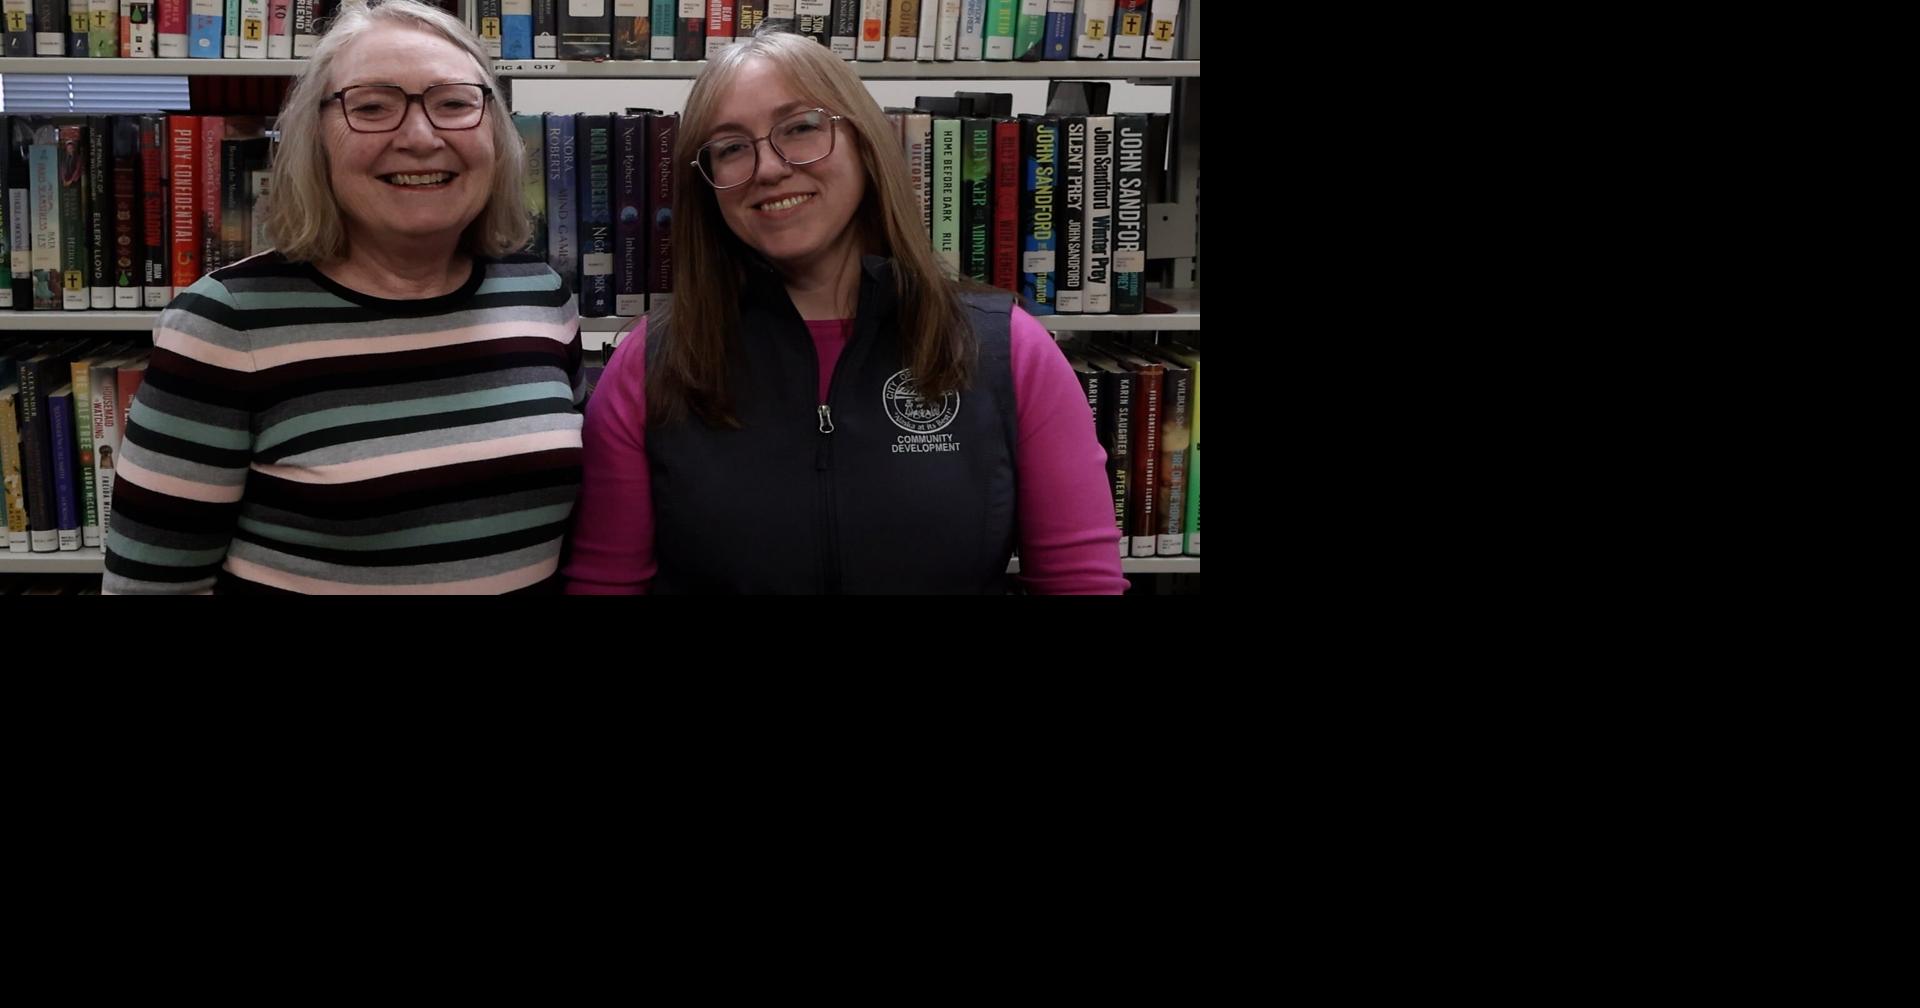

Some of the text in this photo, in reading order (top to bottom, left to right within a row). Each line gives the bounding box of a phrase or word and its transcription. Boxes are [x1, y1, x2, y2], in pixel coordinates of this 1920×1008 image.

[740, 5, 753, 30] LANDS
[174, 129, 193, 161] PONY
[548, 127, 563, 181] ROBERTS
[562, 135, 576, 173] NORA
[622, 127, 636, 195] Nora Roberts
[972, 129, 989, 162] RILEY
[1034, 124, 1055, 163] JOHN
[1119, 127, 1143, 172] JOHN
[206, 129, 215, 229] CHAMPAGNE LETTERS
[590, 128, 608, 218] NORA ROBERTS
[657, 128, 672, 199] Nora Roberts
[942, 130, 953, 223] HOME BEFORE DARK
[1066, 123, 1085, 211] SILENT PREY
[1093, 127, 1112, 210] John Sandford
[173, 164, 193, 244] CONFIDENTIAL
[1033, 166, 1054, 241] SANDFORD
[1116, 177, 1142, 251] SANDFOR
[92, 212, 103, 279] ELLERY LLOYD
[557, 188, 570, 267] MIND GAMES
[942, 232, 952, 252] RILE
[971, 223, 987, 266] MIDDLE
[1067, 219, 1081, 242] JOHN
[1091, 215, 1111, 255] Winter
[624, 236, 637, 293] Inheritance
[1066, 242, 1081, 288] SANDFORD
[1087, 257, 1109, 285] Prey
[75, 368, 90, 395] THE
[887, 371, 913, 400] CITY OF
[1088, 378, 1099, 404] KARIN
[1176, 378, 1187, 414] WILBUR
[93, 402, 104, 439] WATCHING
[102, 385, 115, 428] HOUSEMAID
[1117, 379, 1130, 456] KARIN SLAUGHTER
[79, 425, 92, 450] TREE
[891, 442, 961, 453] DEVELOPMENT
[897, 433, 953, 444] COMMUNITY
[83, 467, 94, 490] LAURA
[1115, 469, 1126, 496] AFTER
[1115, 498, 1125, 518] THAT
[1168, 502, 1182, 535] HORIZO
